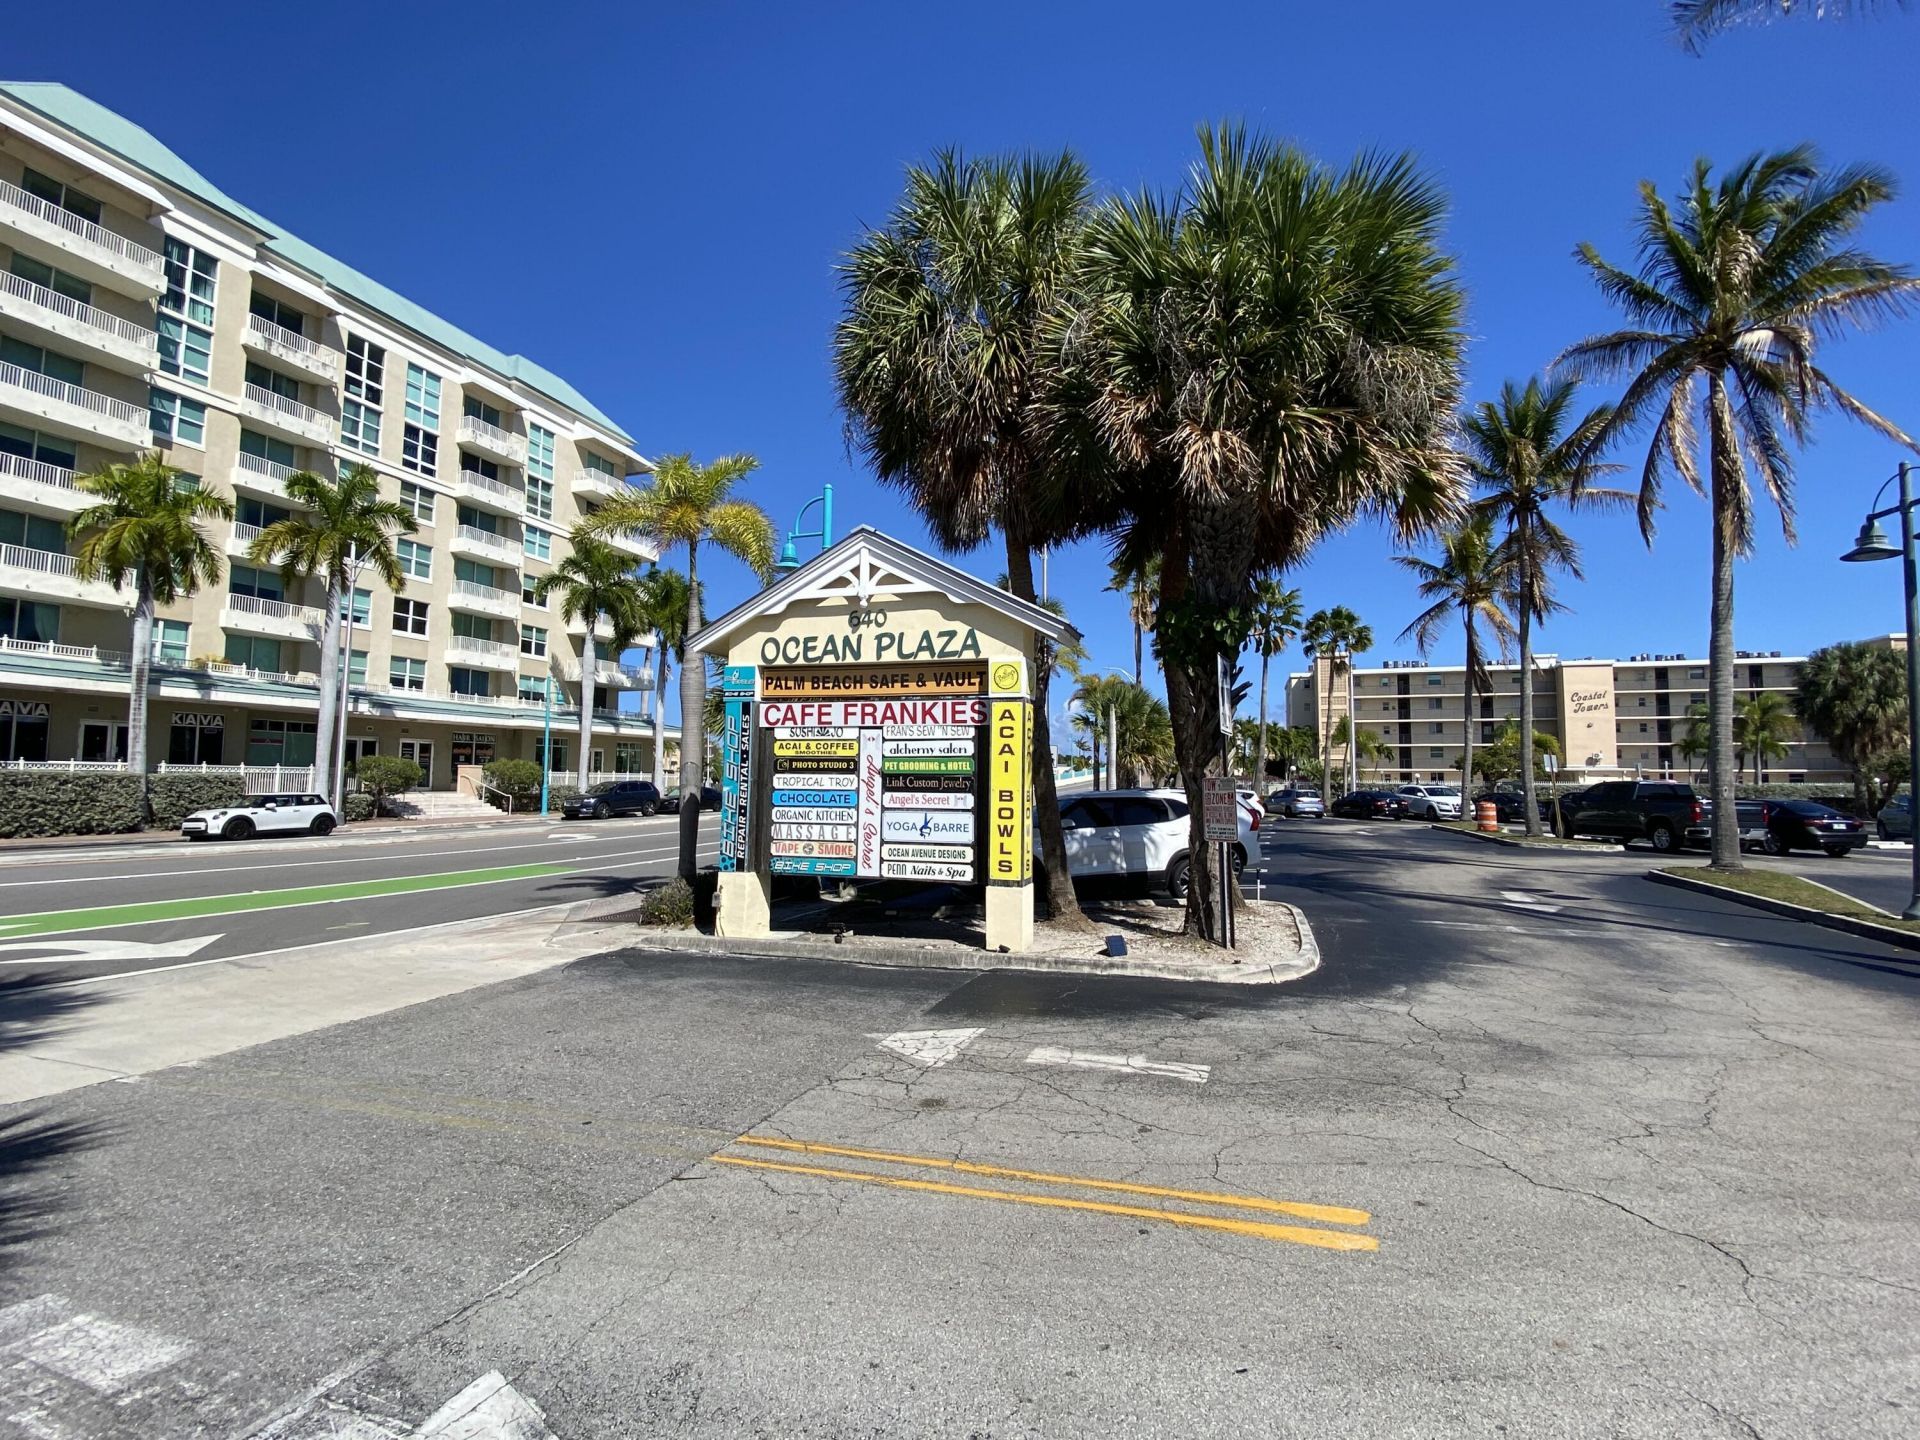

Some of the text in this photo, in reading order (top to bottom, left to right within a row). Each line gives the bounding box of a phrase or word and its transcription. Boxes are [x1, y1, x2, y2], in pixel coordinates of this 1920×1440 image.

[848, 609, 887, 629] 640
[761, 628, 981, 664] OCEAN PLAZA
[765, 676, 805, 690] PALM
[811, 675, 863, 690] BEACH
[869, 673, 909, 689] SAFE
[916, 673, 927, 687] &
[933, 670, 986, 687] VAULT
[1571, 690, 1607, 702] Coastal
[764, 700, 988, 726] CAFE FRANKIES
[1573, 702, 1608, 713] Towers
[171, 713, 224, 726] KAVA
[789, 727, 843, 737] SUSHI JO
[886, 725, 914, 736] FRAN'S
[916, 725, 935, 736] SEW
[950, 725, 969, 736] SEW
[726, 715, 740, 782] SHOP
[778, 742, 855, 750] ACAI & COFFEE
[889, 742, 967, 755] alchemy salon
[884, 761, 971, 770] PET GROOMING & HOTEL
[737, 714, 750, 859] REPAIR RENTAL SALES
[776, 777, 855, 787] TROPICAL TROY
[886, 776, 971, 791] Link Custom Jewelry
[997, 708, 1015, 873] ACAI BOWLS
[780, 794, 851, 804] CHOCOLATE
[888, 794, 950, 806] Angel's Secret
[1211, 793, 1228, 804] ZONE
[775, 810, 853, 821] ORGANIC KITCHEN
[772, 824, 853, 840] MASSAGE
[887, 822, 970, 833] YOGA BARRE
[774, 843, 854, 856] VAPE SMOKE
[888, 848, 966, 860] OCEAN AVENUE DESIGNS
[814, 862, 851, 872] SHOP
[910, 865, 936, 876] Nails
[945, 867, 966, 879] Spa
